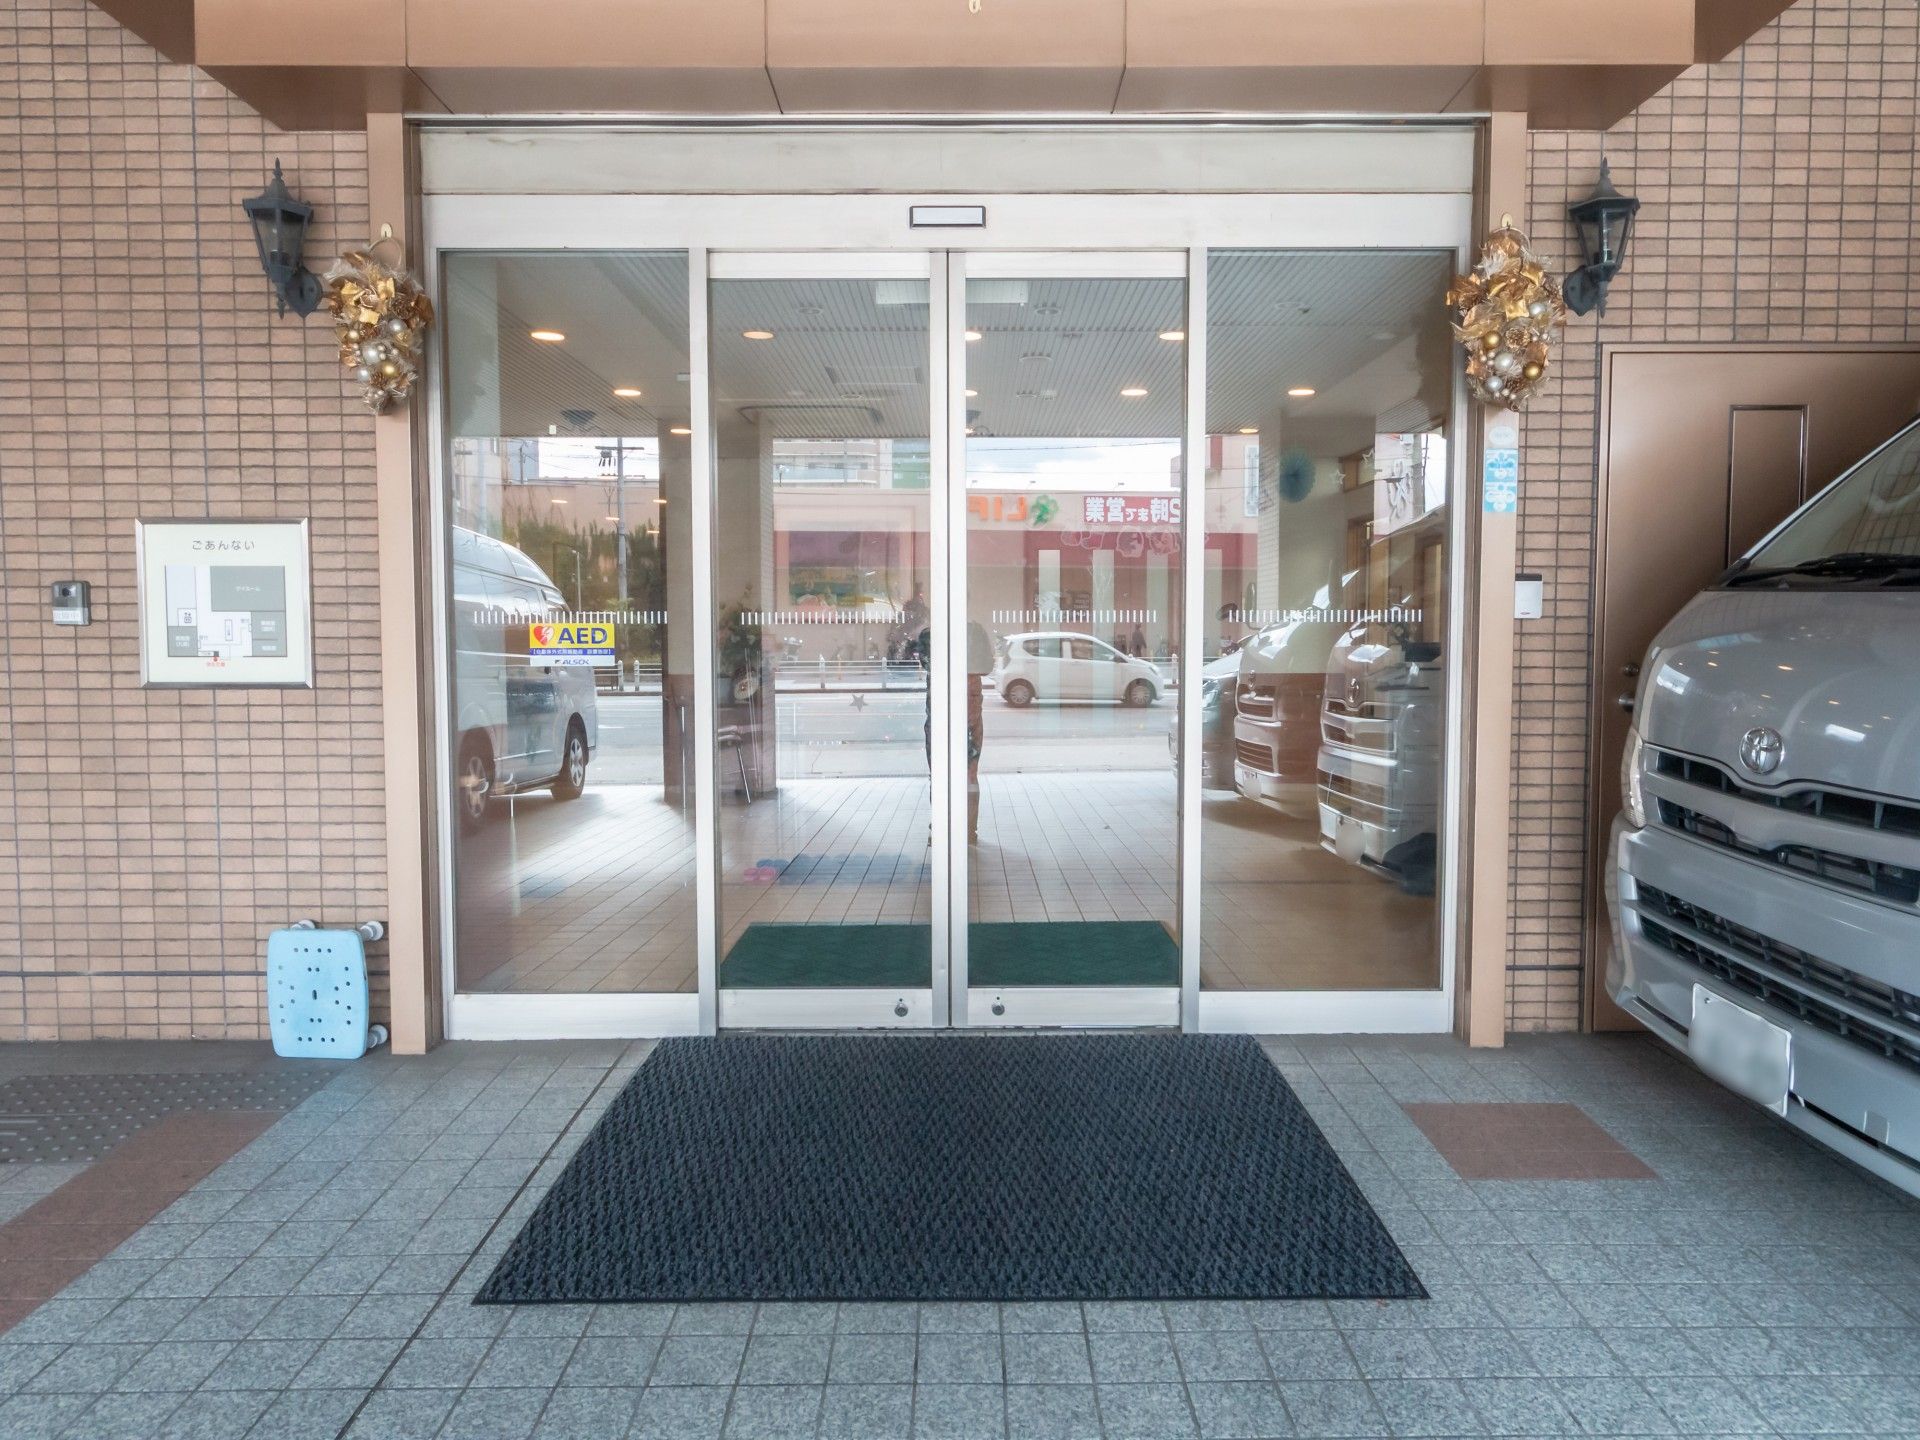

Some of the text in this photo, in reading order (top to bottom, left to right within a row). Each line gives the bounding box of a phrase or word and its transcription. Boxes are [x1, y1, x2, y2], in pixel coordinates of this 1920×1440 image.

[192, 540, 255, 551] ごあんない
[558, 628, 607, 644] AED
